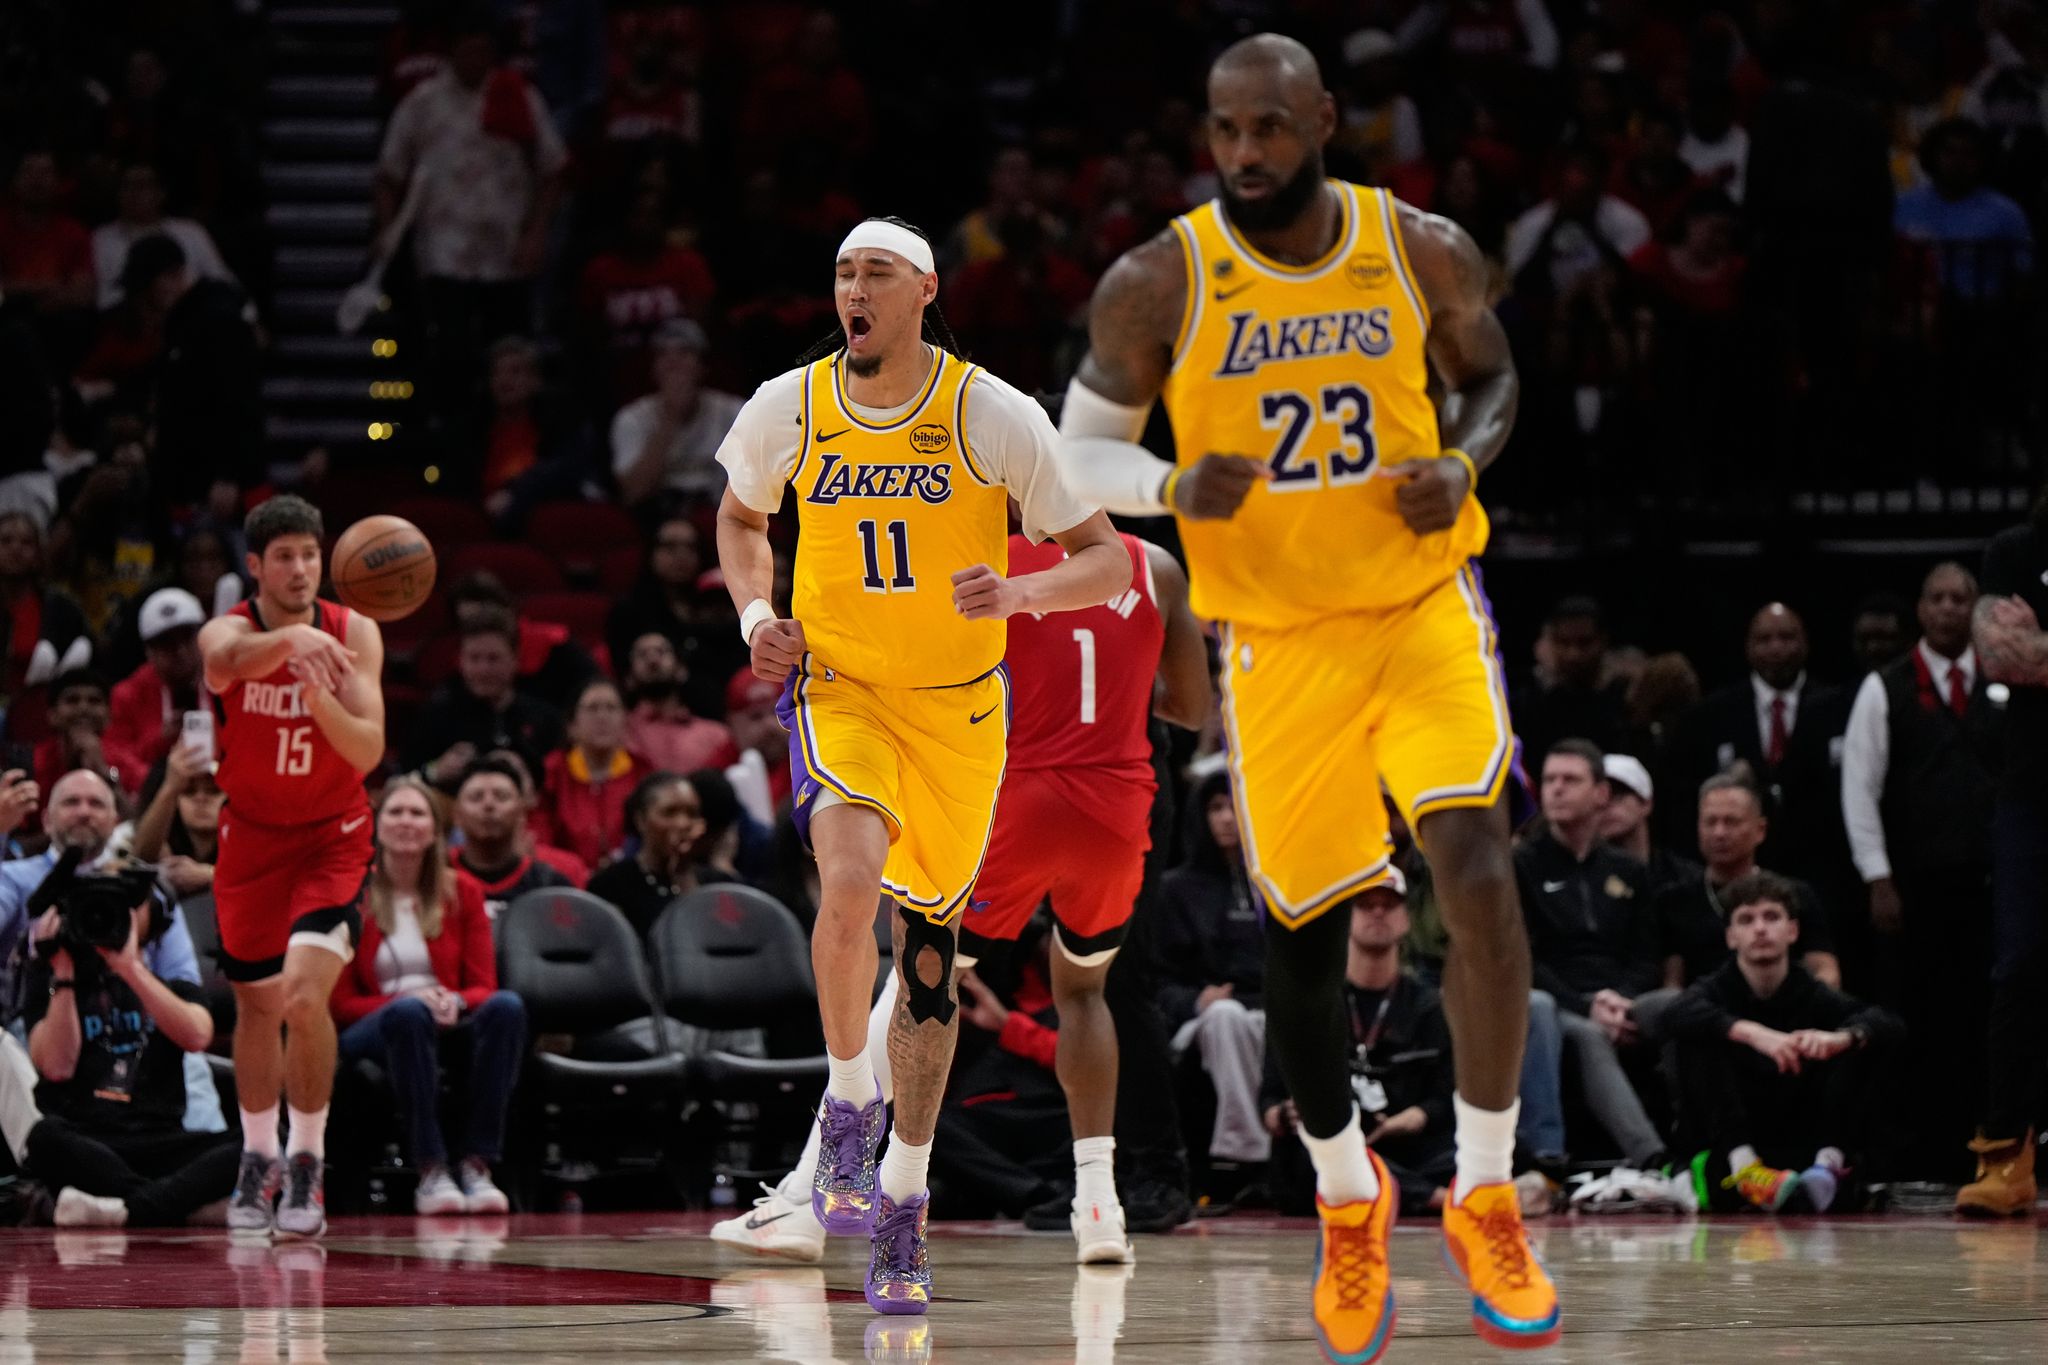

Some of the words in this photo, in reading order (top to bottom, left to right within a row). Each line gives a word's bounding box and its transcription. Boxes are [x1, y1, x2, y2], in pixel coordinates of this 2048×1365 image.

[1212, 306, 1394, 379] LAKERS
[913, 432, 948, 446] bibigo
[1260, 380, 1379, 493] 23
[805, 453, 953, 506] LAKERS
[856, 519, 917, 594] 11
[242, 681, 312, 719] ROCK
[1072, 628, 1096, 724] 1
[275, 726, 313, 776] 15
